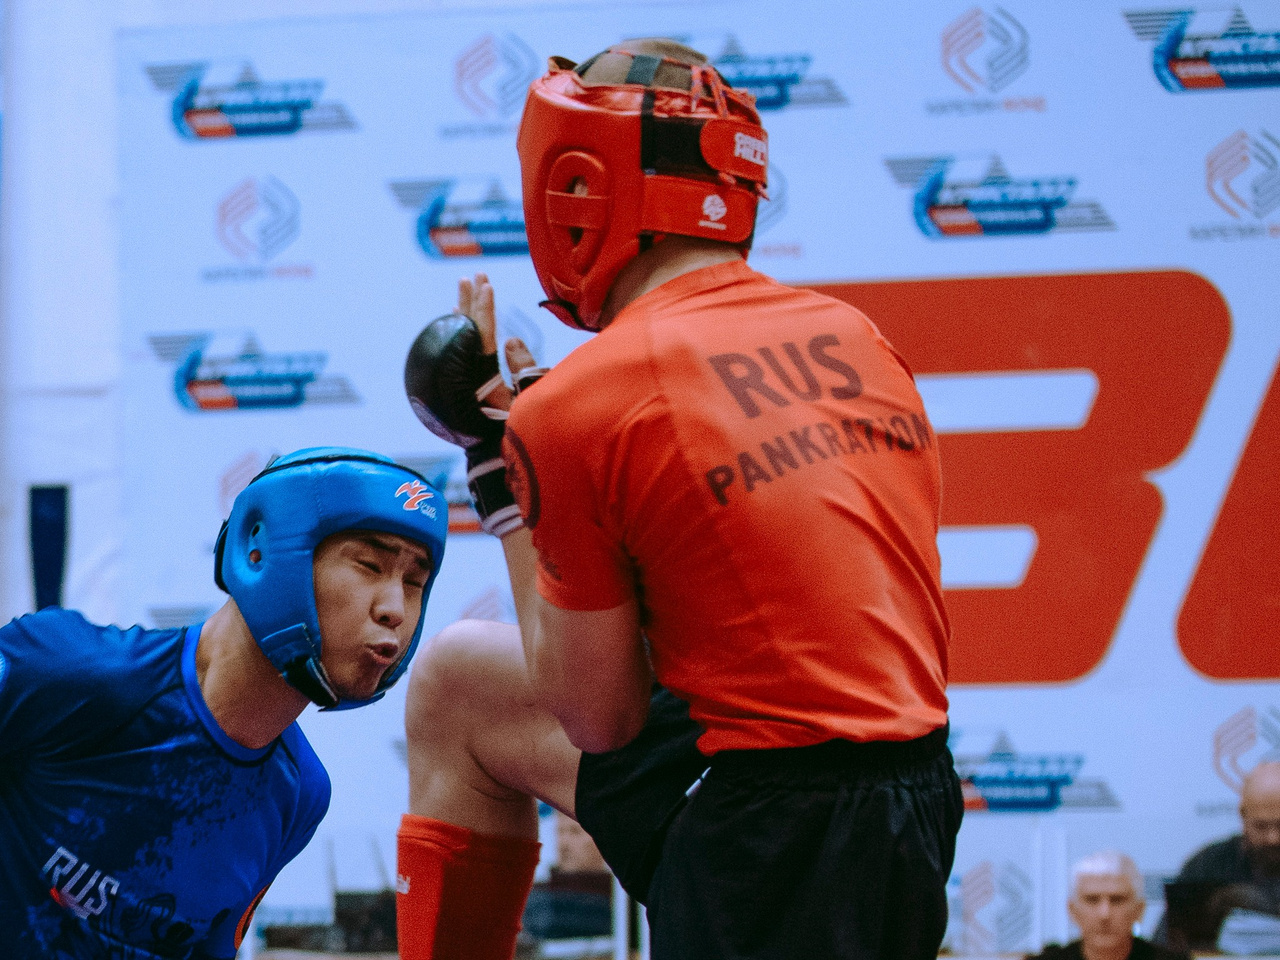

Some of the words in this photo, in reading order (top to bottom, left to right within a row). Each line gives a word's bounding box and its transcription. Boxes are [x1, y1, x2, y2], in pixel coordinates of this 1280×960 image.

[708, 334, 862, 419] RUS
[706, 413, 932, 506] PANKRATION
[41, 846, 120, 917] RUS
